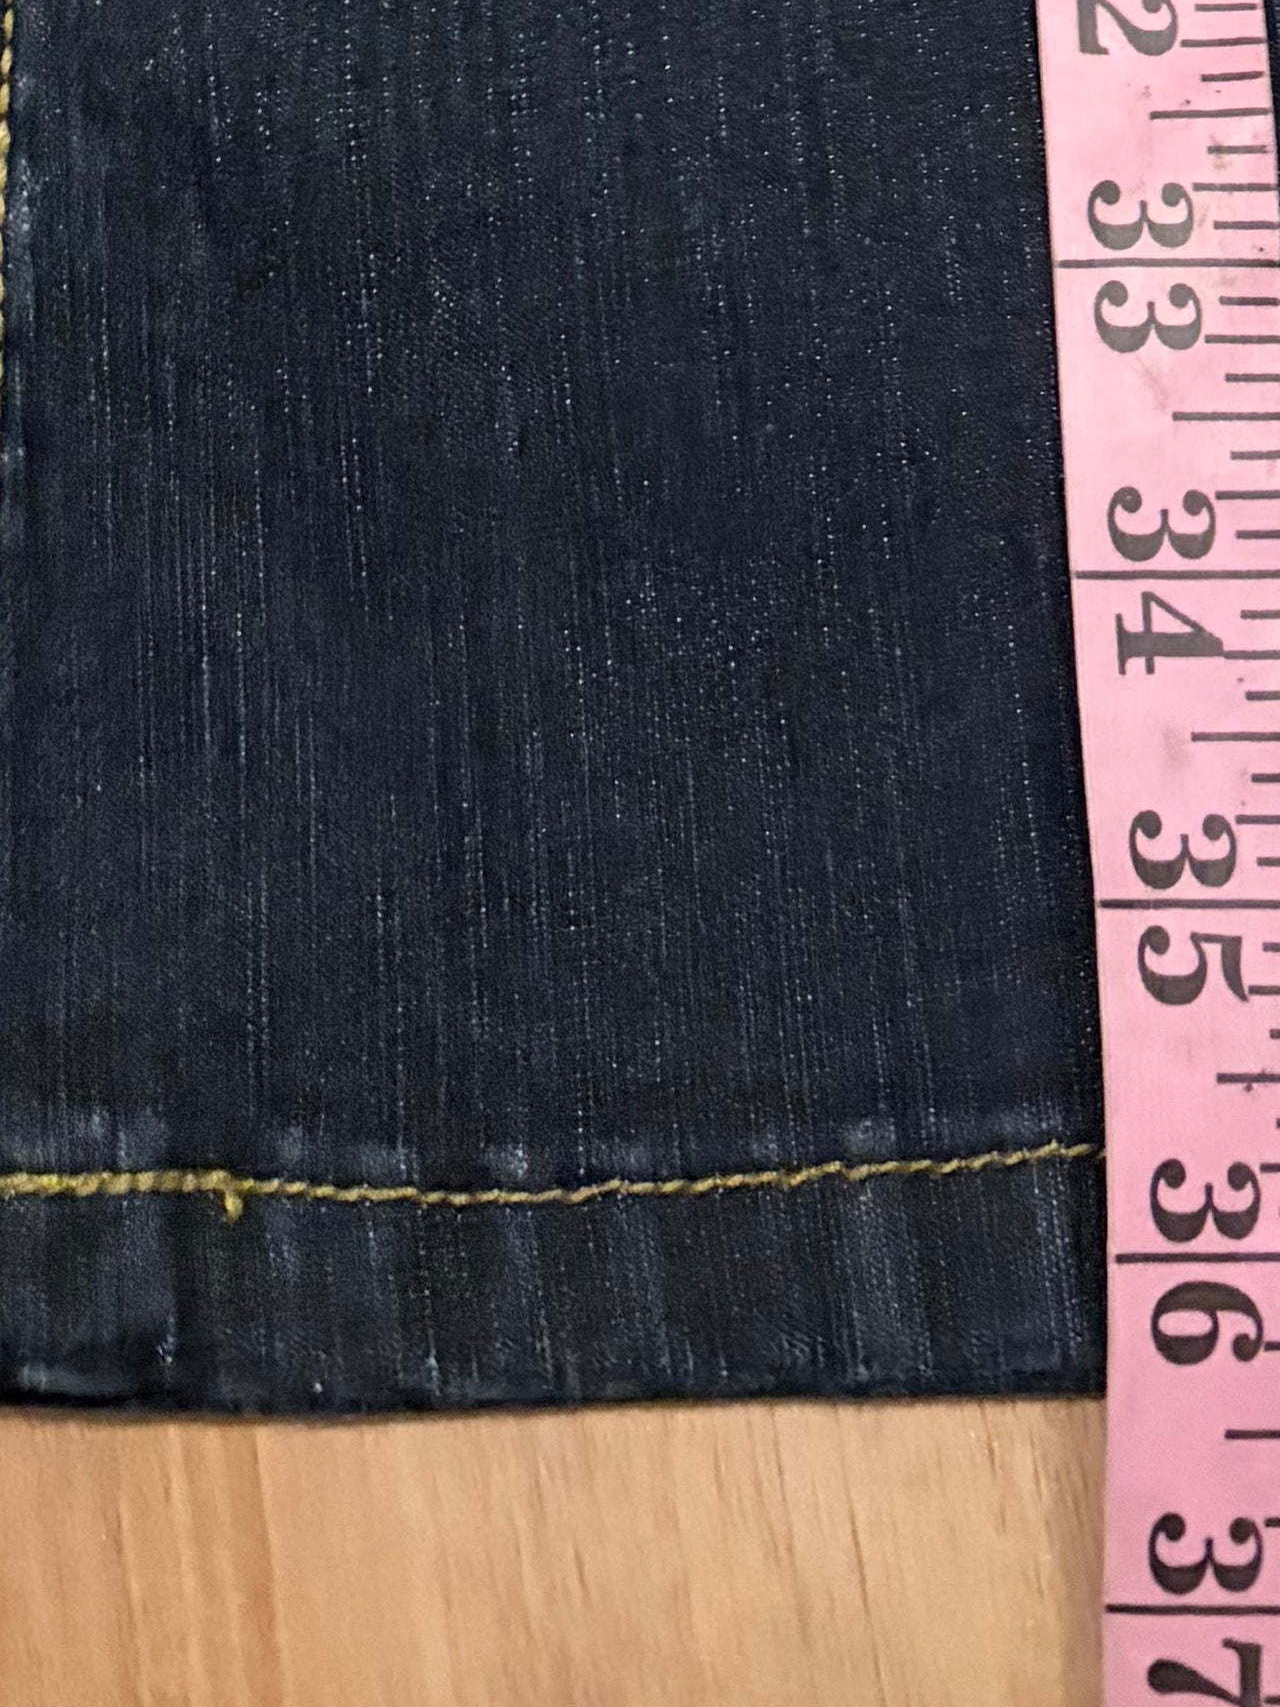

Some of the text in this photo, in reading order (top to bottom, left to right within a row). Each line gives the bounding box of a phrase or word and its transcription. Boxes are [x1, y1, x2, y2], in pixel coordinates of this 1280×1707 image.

[1087, 179, 1202, 353] 33
[1107, 486, 1223, 675] 34
[1128, 810, 1249, 1006] 35
[1149, 1158, 1263, 1366] 36
[1147, 1512, 1263, 1707] 37
